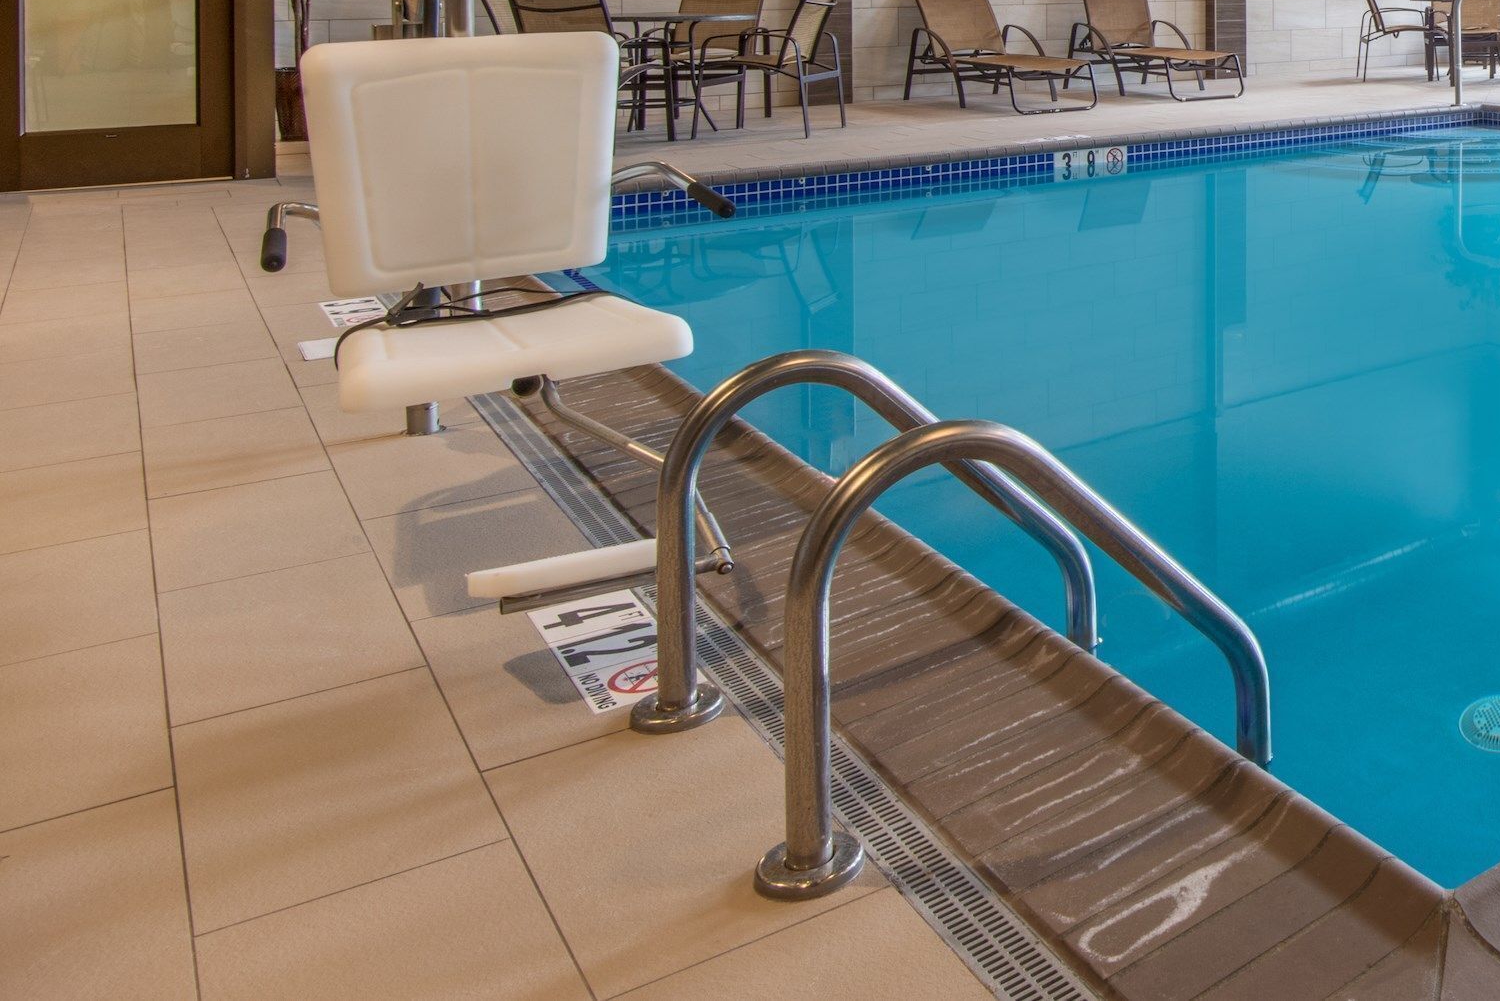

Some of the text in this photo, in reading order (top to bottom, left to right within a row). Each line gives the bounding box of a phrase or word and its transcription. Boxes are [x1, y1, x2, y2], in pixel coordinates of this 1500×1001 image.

[543, 602, 637, 630] 4
[578, 673, 617, 710] NO DIVING
